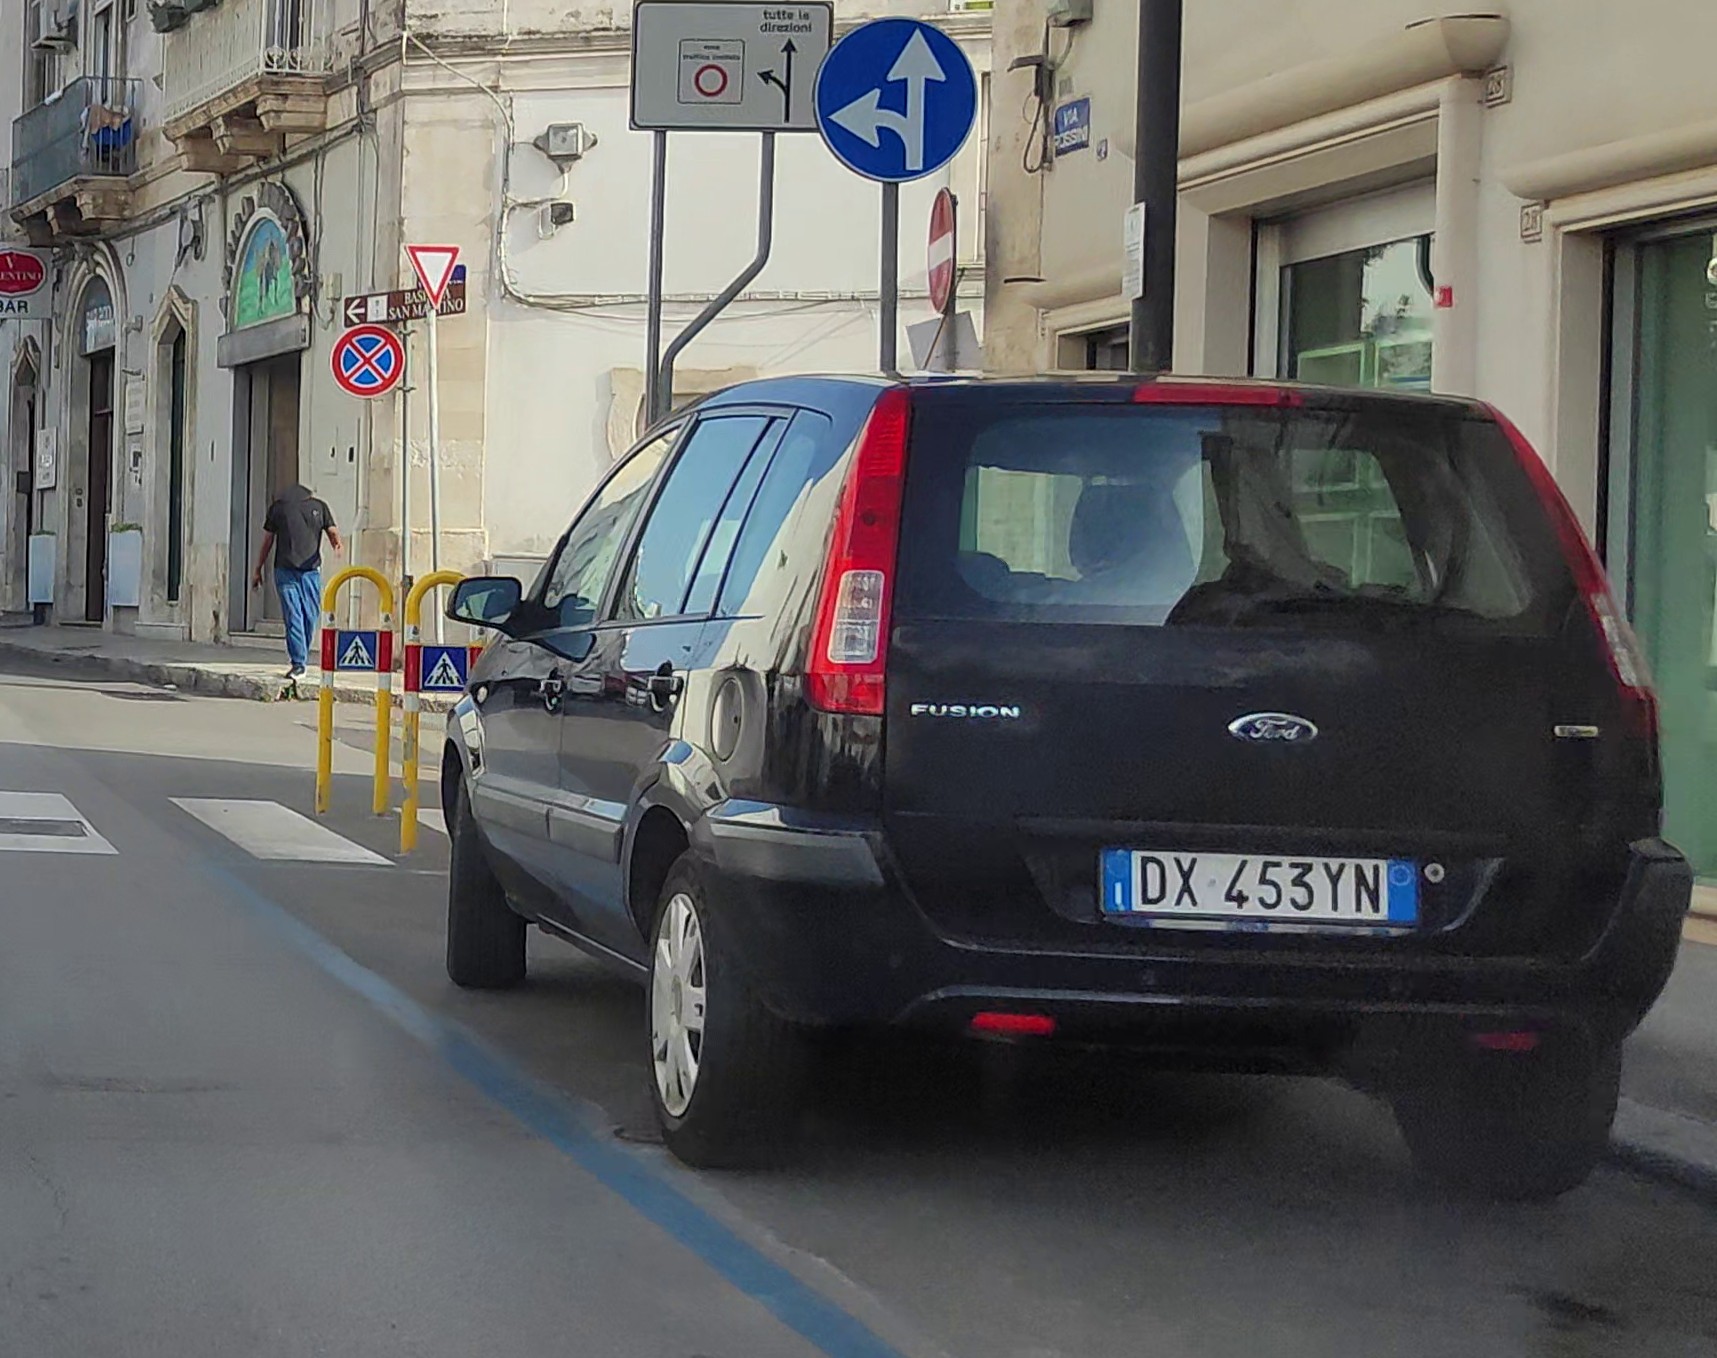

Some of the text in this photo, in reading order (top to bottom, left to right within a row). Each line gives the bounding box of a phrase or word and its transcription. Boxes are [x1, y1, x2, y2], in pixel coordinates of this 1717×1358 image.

[763, 9, 810, 20] tutte le
[760, 22, 812, 33] direzioni
[1063, 107, 1079, 127] VIA
[404, 289, 451, 304] BASIA
[388, 299, 464, 320] SAN MATINO
[910, 704, 1020, 718] FUSION
[1249, 719, 1300, 740] Ford
[1140, 855, 1198, 907] DX
